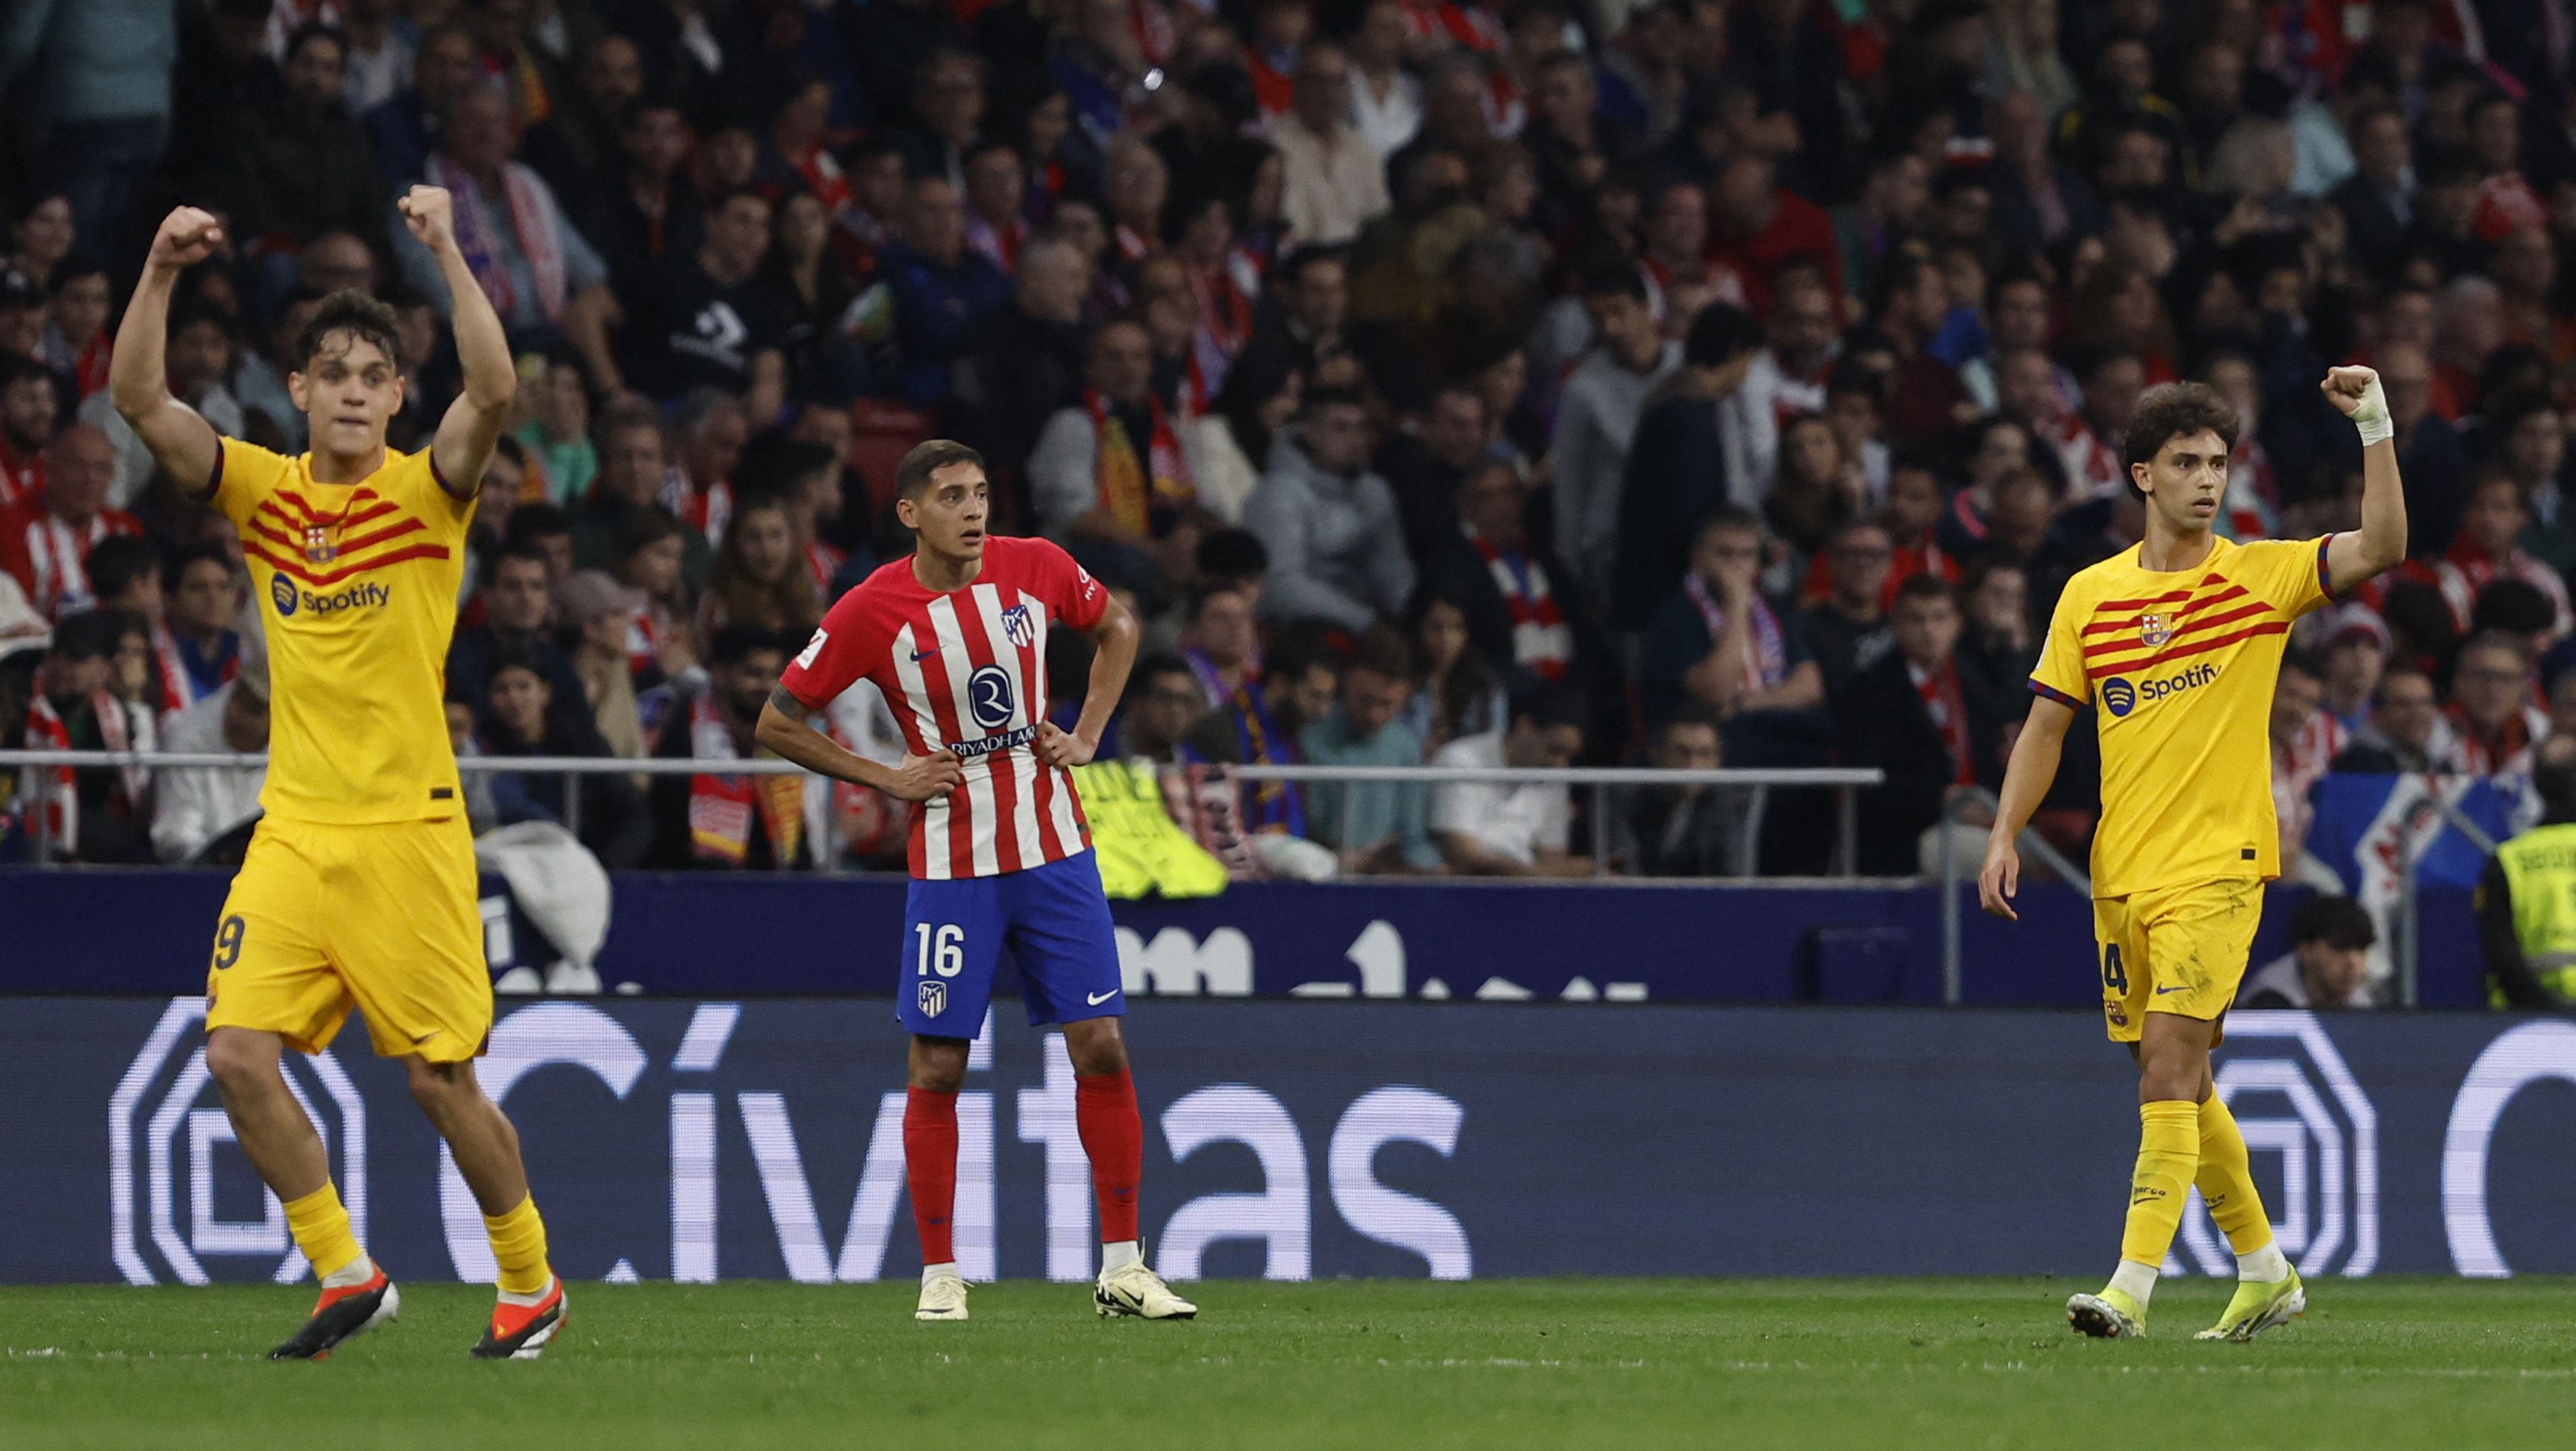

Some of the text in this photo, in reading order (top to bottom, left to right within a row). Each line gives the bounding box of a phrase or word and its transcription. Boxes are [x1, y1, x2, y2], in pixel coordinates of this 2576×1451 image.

[302, 581, 390, 614] Spotify
[952, 732, 1012, 756] RIYADH
[915, 923, 964, 978] 16
[439, 1001, 1474, 1284] Cívitas
